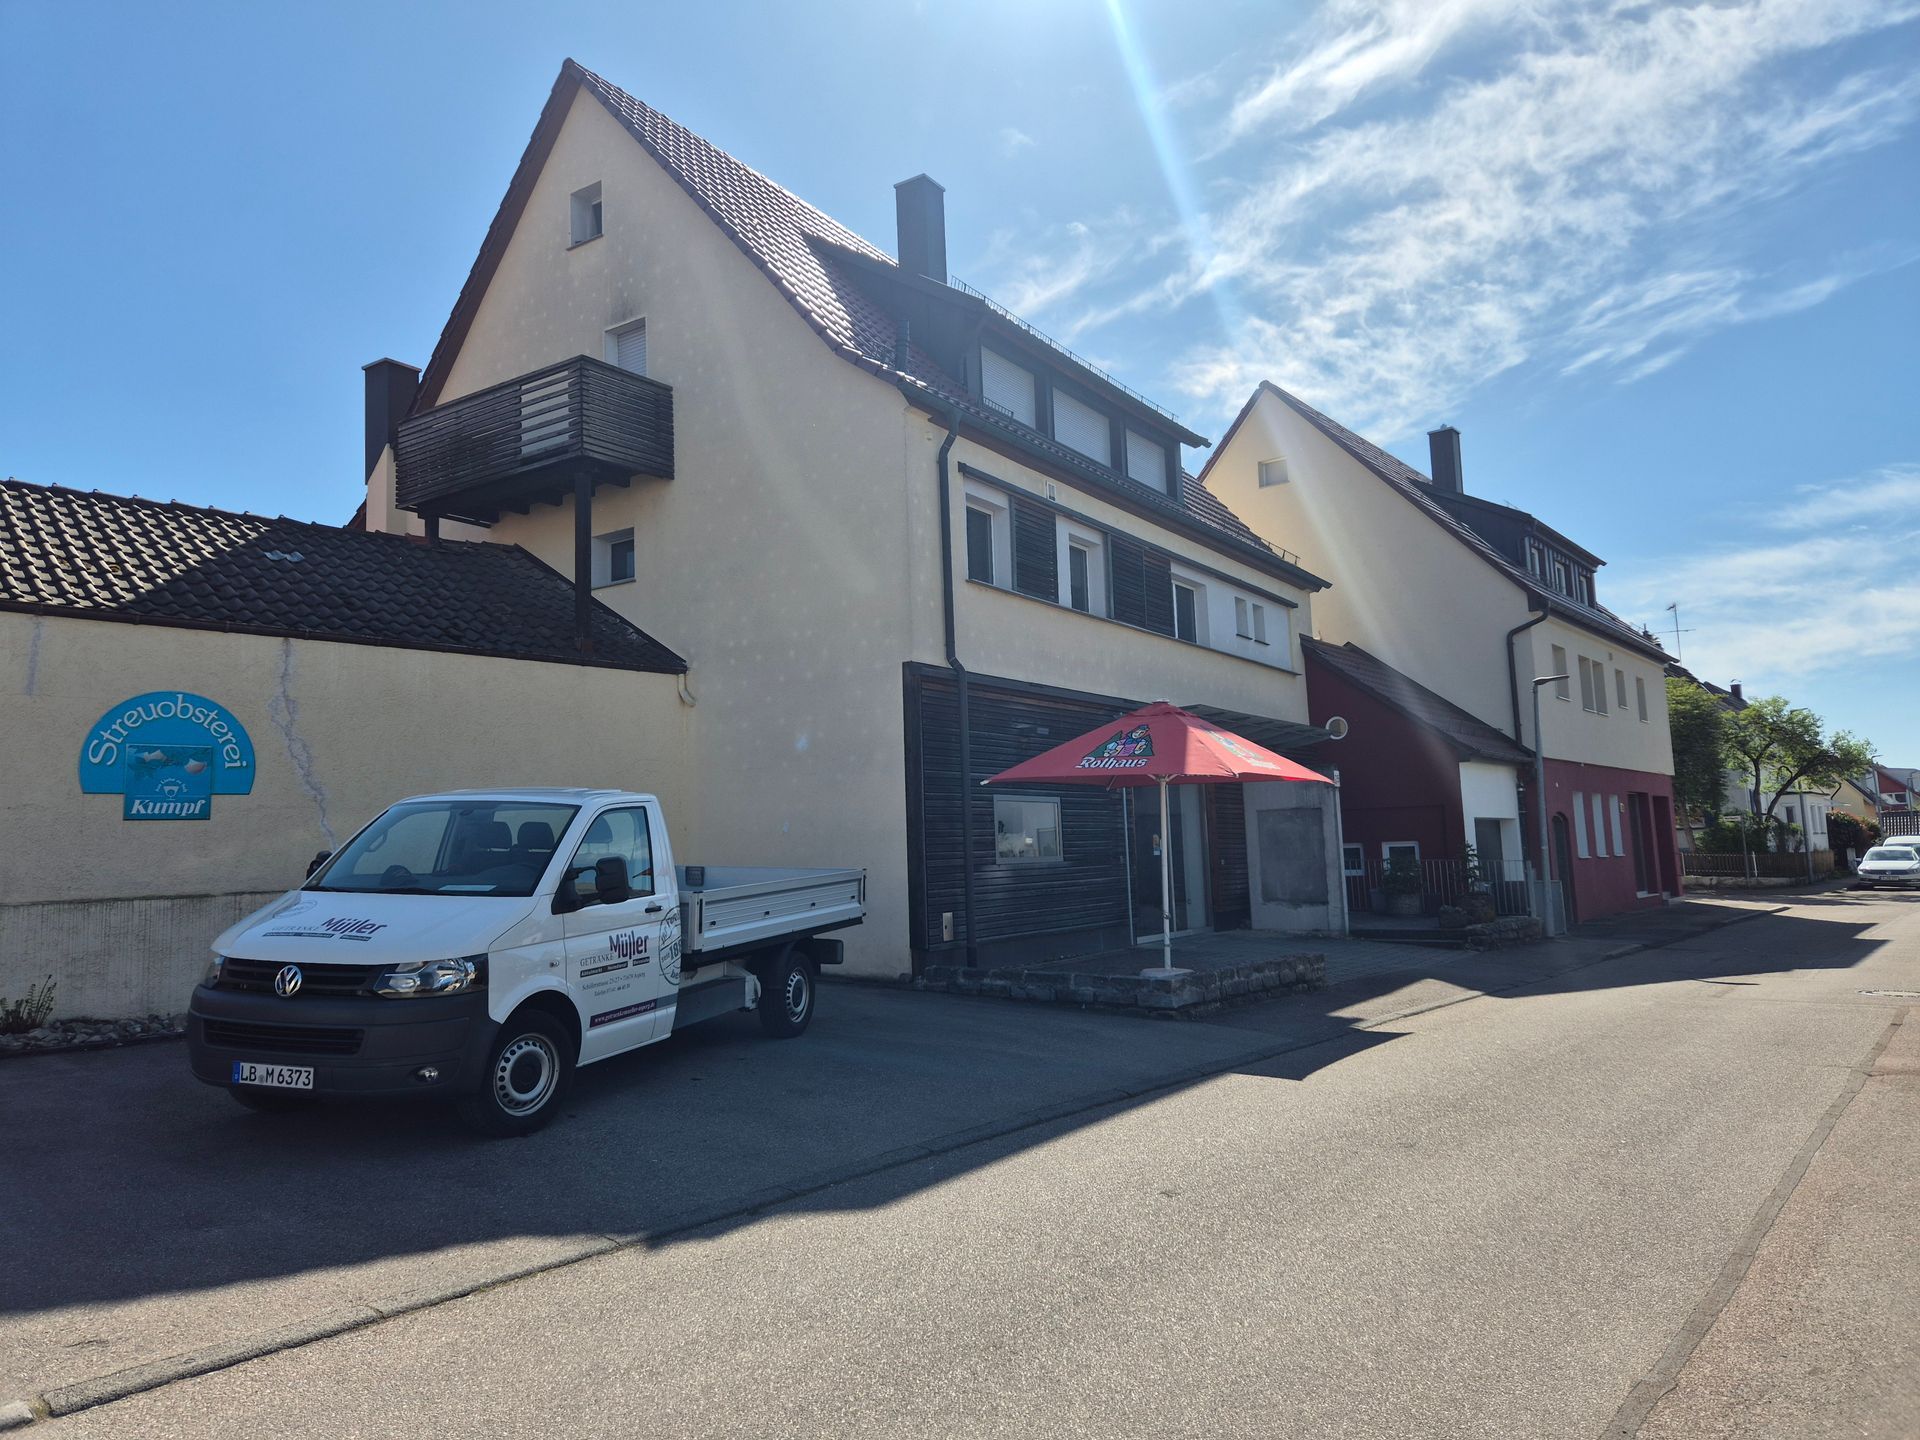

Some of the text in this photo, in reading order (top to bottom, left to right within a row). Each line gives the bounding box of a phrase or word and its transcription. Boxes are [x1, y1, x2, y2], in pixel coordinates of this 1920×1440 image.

[88, 694, 248, 769] Streuobsterei
[1075, 756, 1148, 770] Rothaus
[131, 799, 206, 817] Kumpf
[321, 917, 388, 935] Müller
[609, 930, 649, 960] Müller
[240, 1065, 257, 1082] LB
